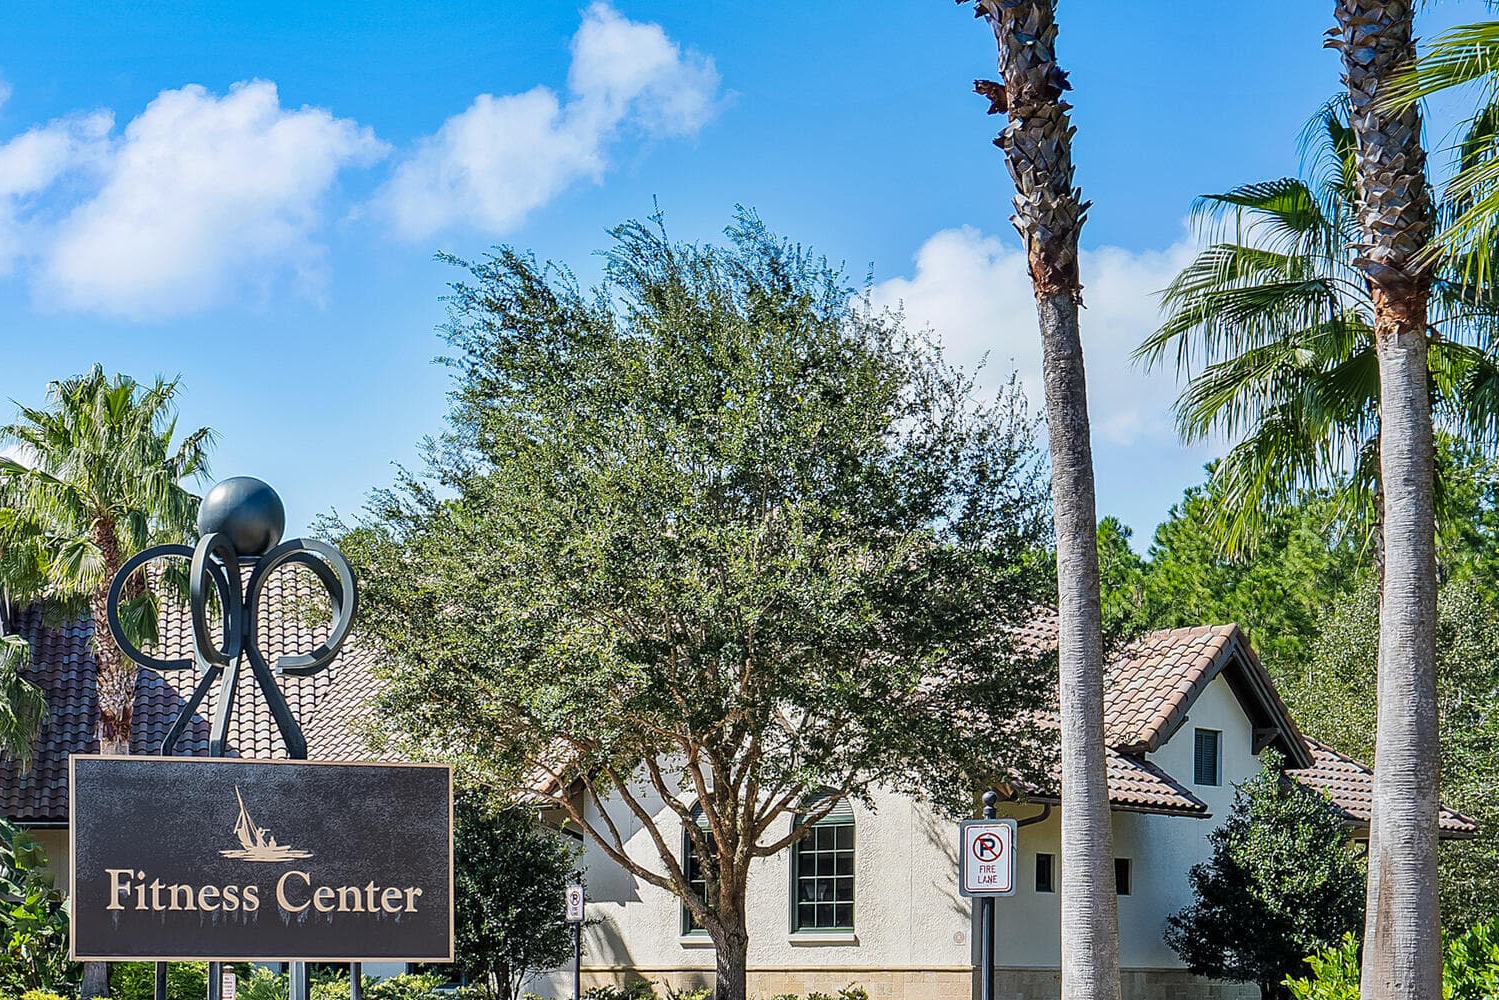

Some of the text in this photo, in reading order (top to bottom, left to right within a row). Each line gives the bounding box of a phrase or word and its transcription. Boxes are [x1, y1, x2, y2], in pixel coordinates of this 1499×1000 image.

[979, 865, 996, 873] FIRE
[977, 875, 998, 884] LANE
[104, 868, 424, 914] Fitness Center
